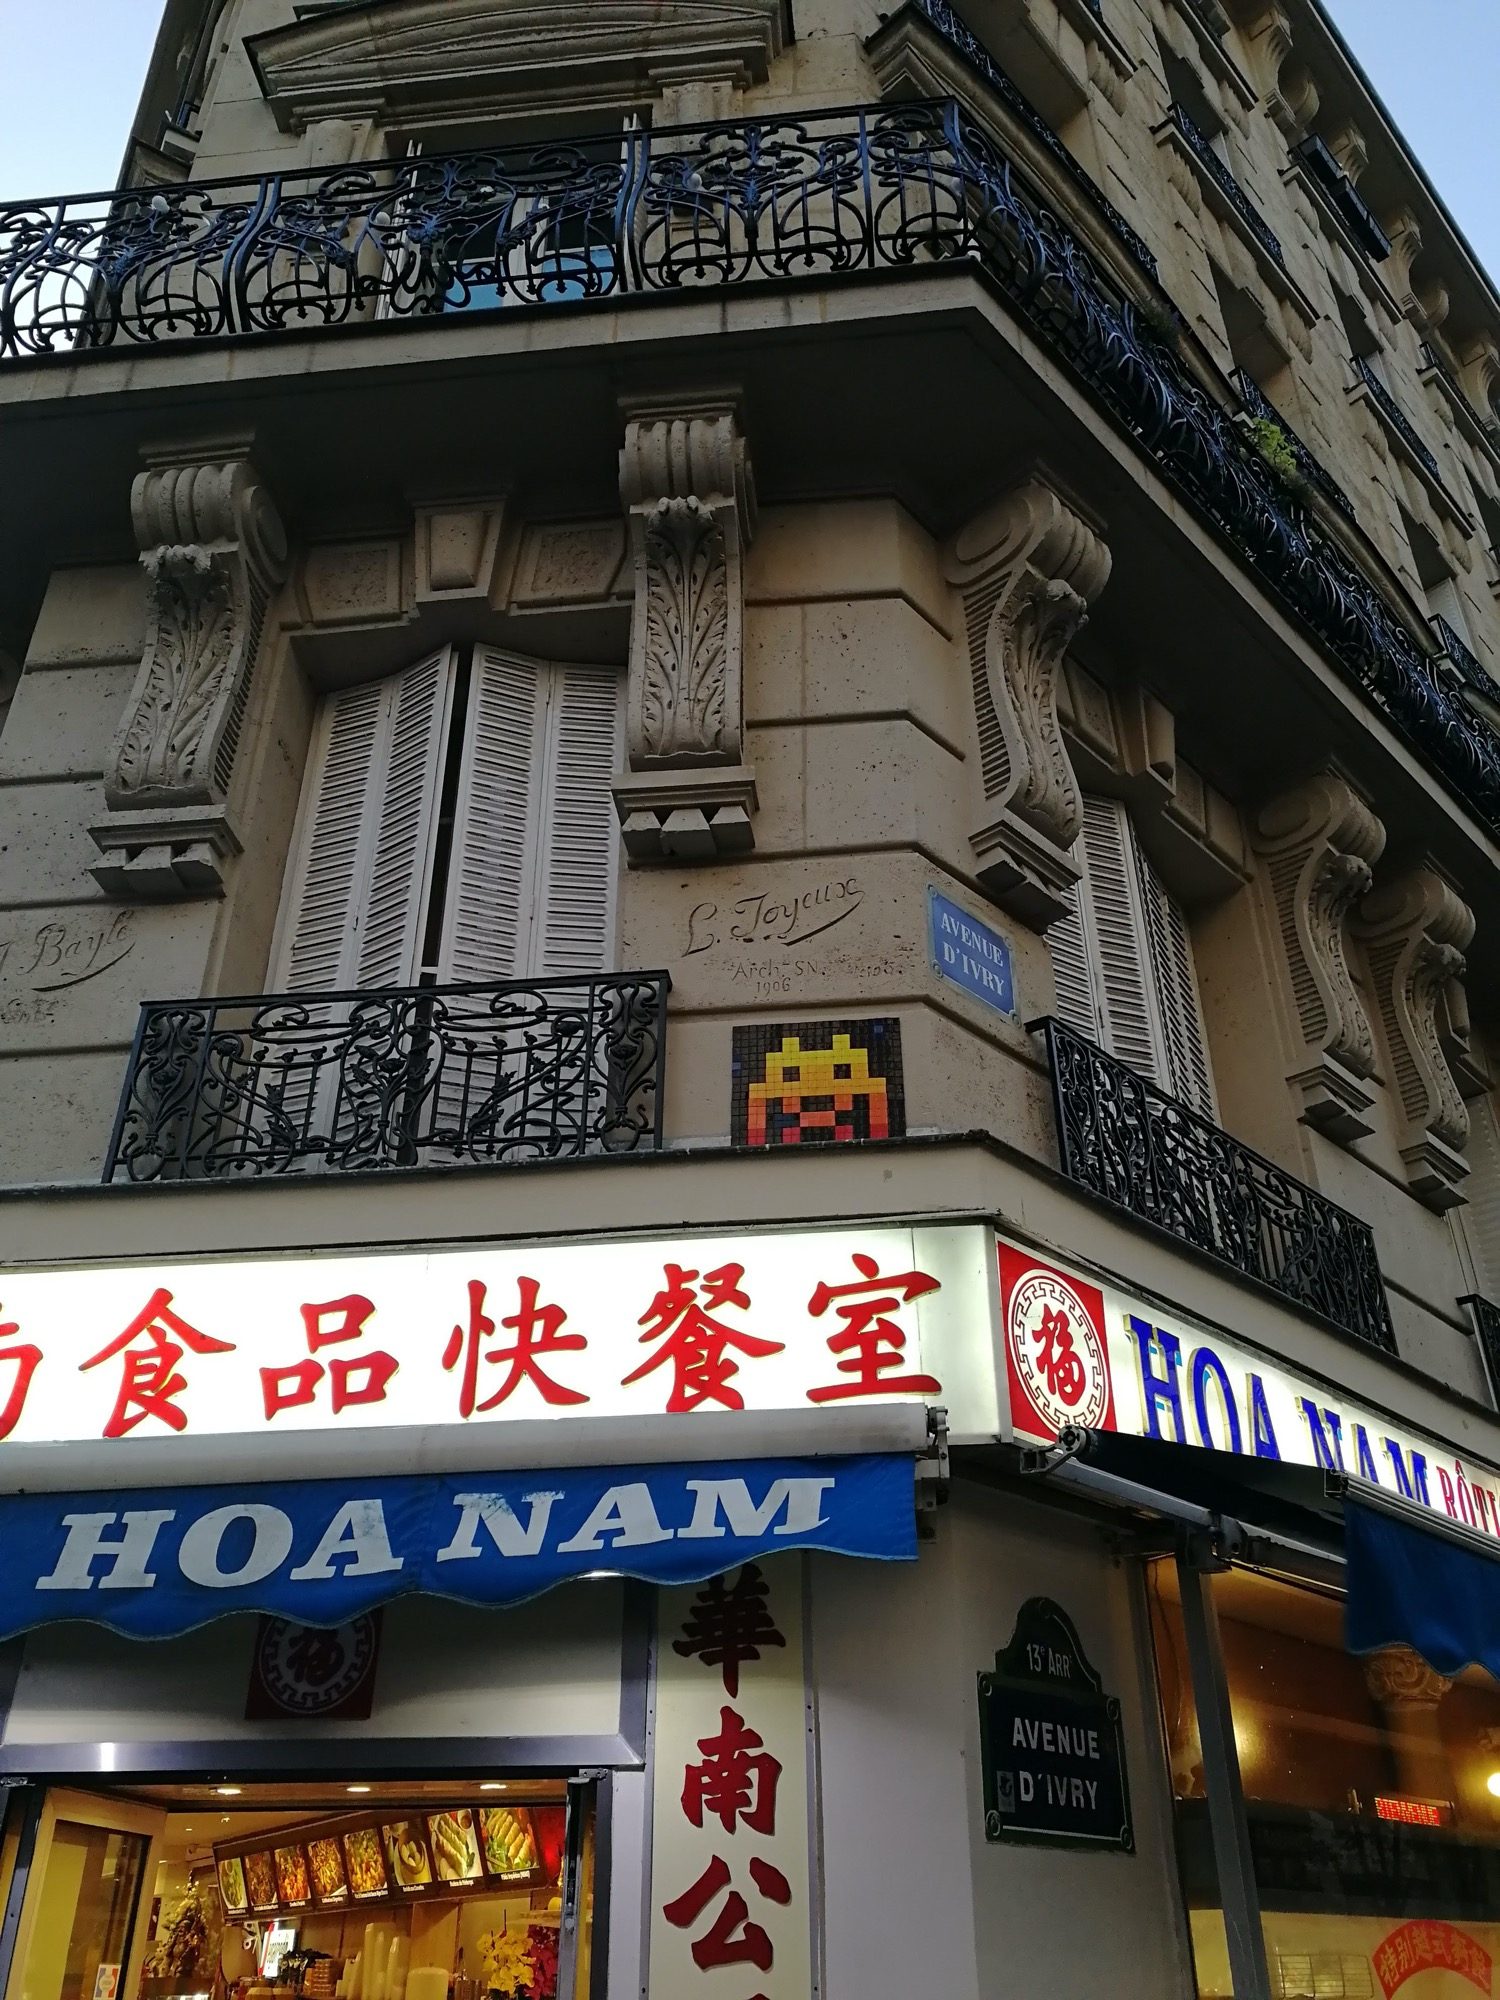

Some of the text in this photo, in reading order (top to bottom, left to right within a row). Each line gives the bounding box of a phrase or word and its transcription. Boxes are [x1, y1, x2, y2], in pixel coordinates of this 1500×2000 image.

[941, 912, 1004, 967] AVENUE
[756, 977, 791, 997] 1906
[943, 941, 1004, 996] D'IVRY
[1124, 1313, 1431, 1507] HOA NAM
[35, 1478, 835, 1590] HOA NAM
[1026, 1643, 1046, 1672] 13e
[1012, 1716, 1100, 1760] AVENUE
[663, 1563, 792, 2000] 華南公
[1019, 1770, 1098, 1810] D'IVRY
